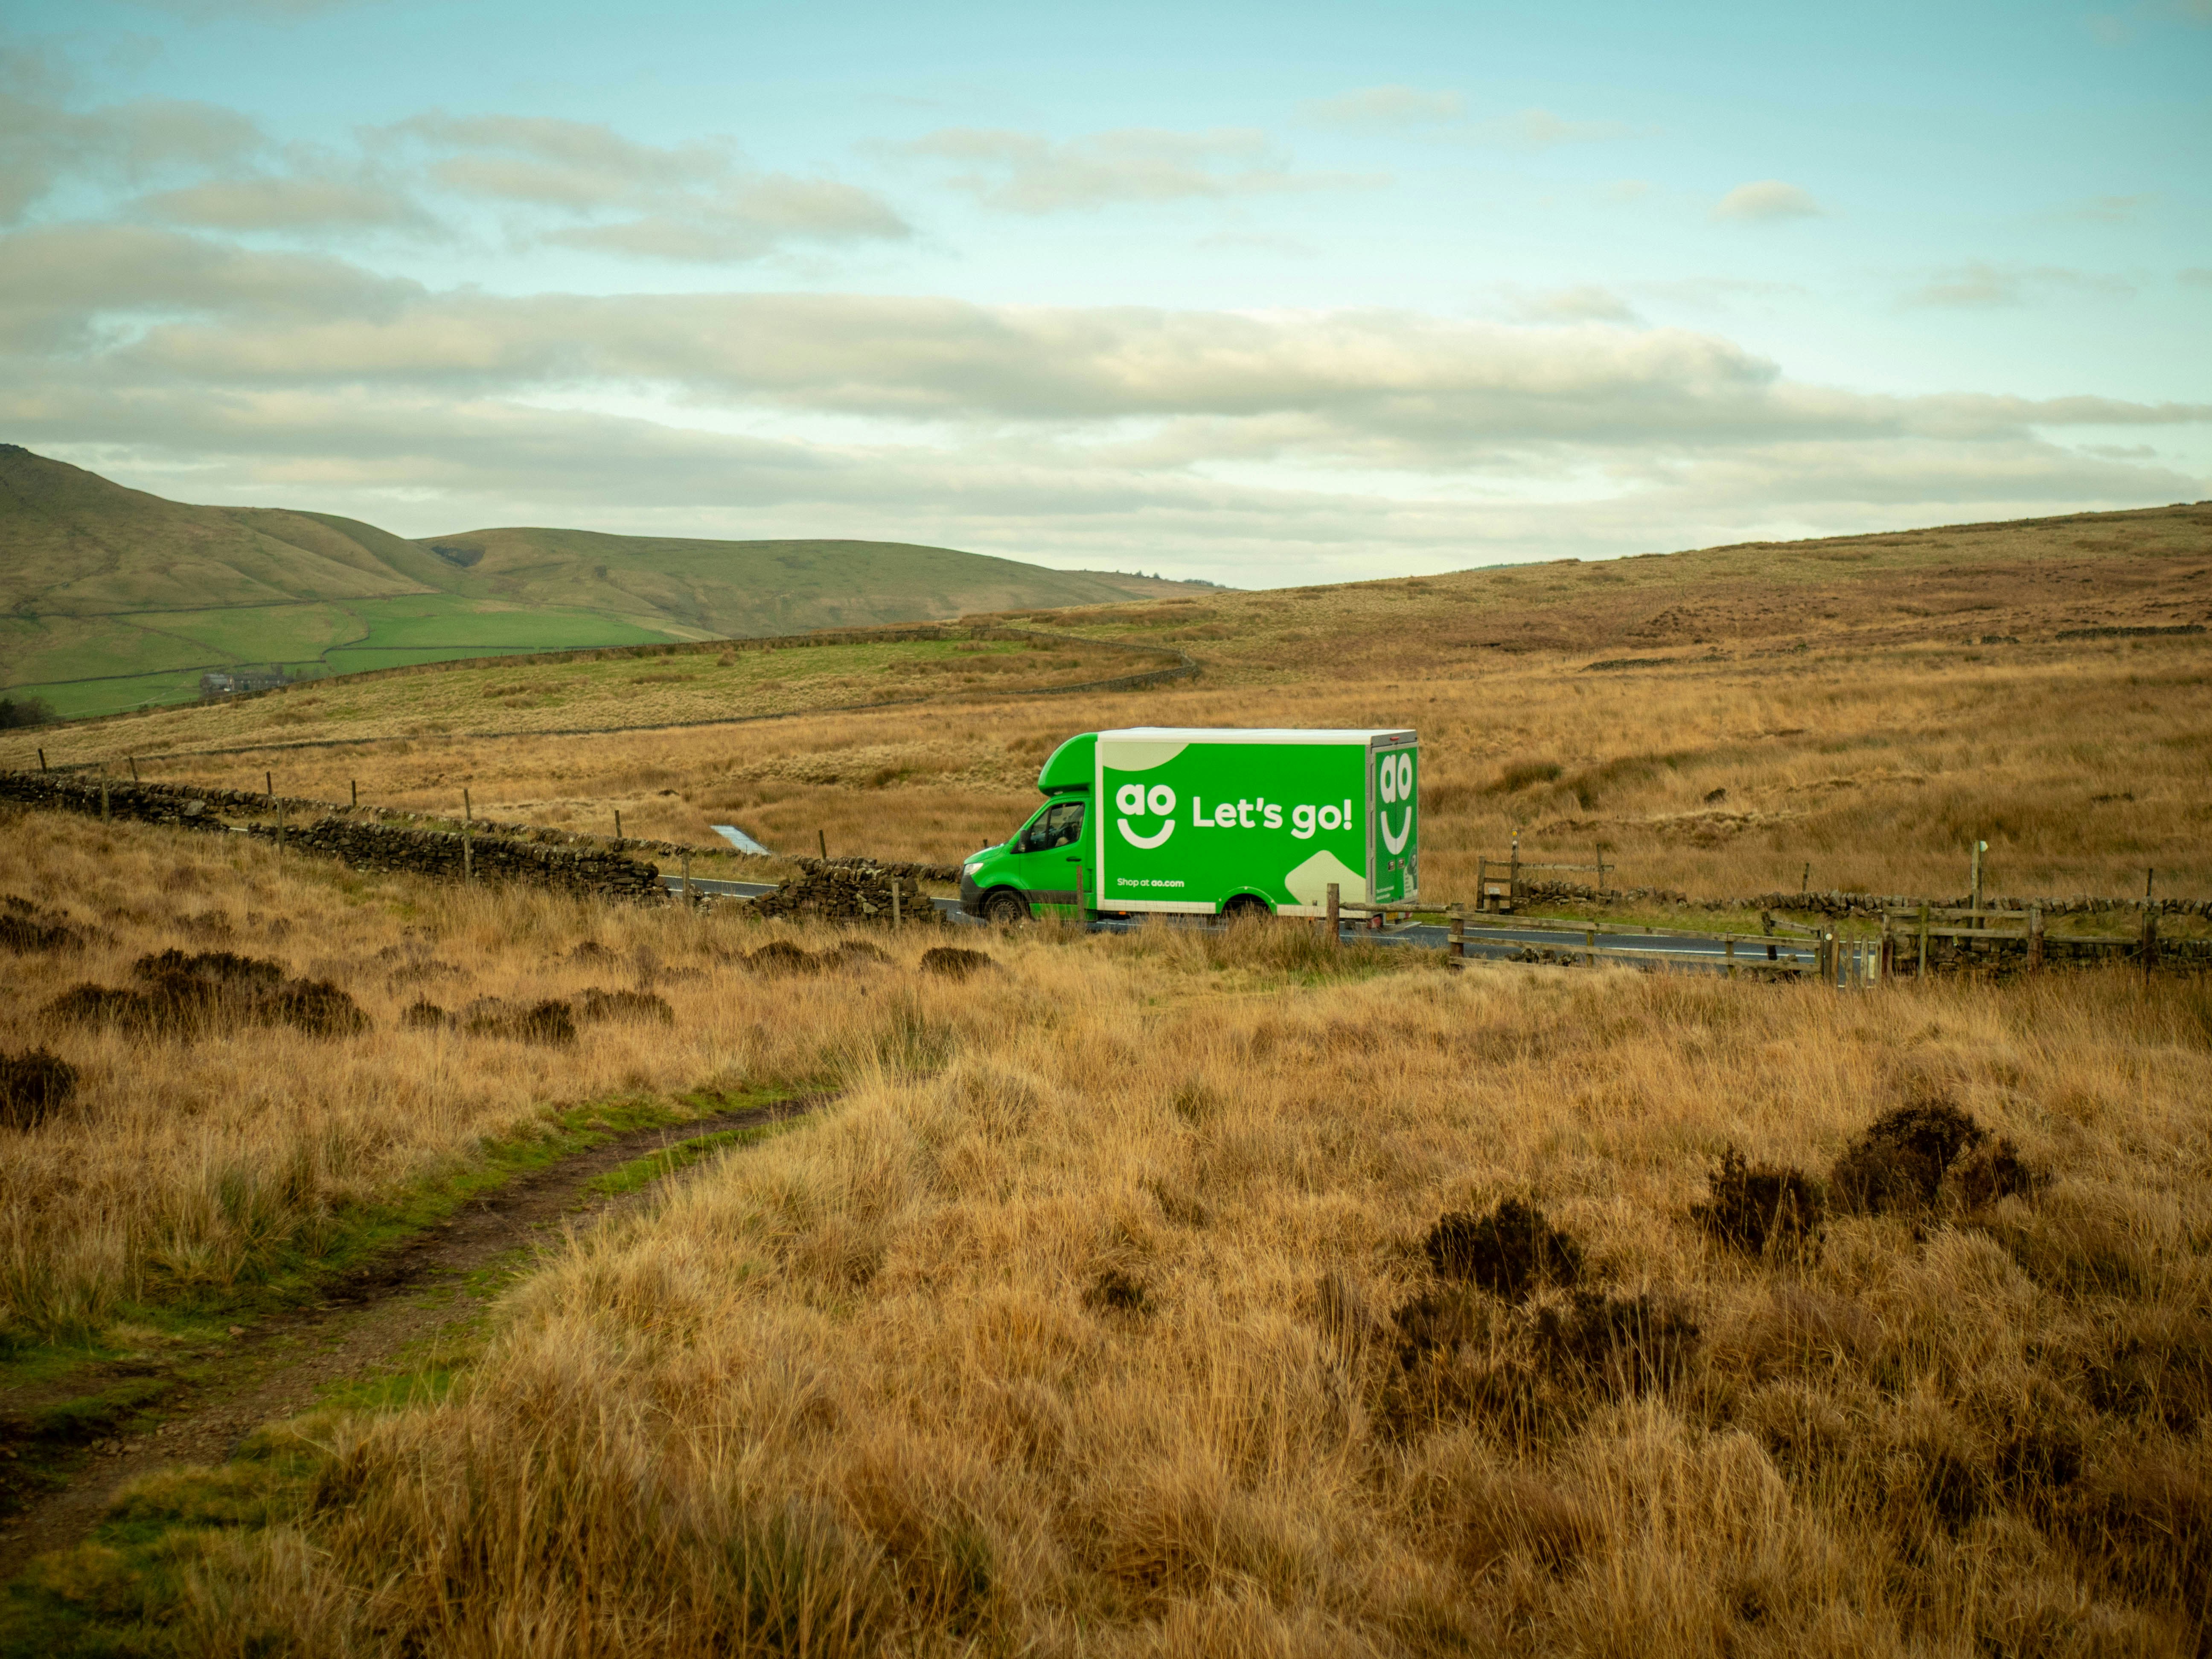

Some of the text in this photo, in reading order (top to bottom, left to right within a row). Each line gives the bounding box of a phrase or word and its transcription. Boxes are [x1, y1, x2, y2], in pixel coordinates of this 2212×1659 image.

[1380, 753, 1412, 803] ao
[1116, 784, 1176, 816] ao
[1193, 796, 1352, 839] Let's go!
[1117, 878, 1139, 888] Shop
